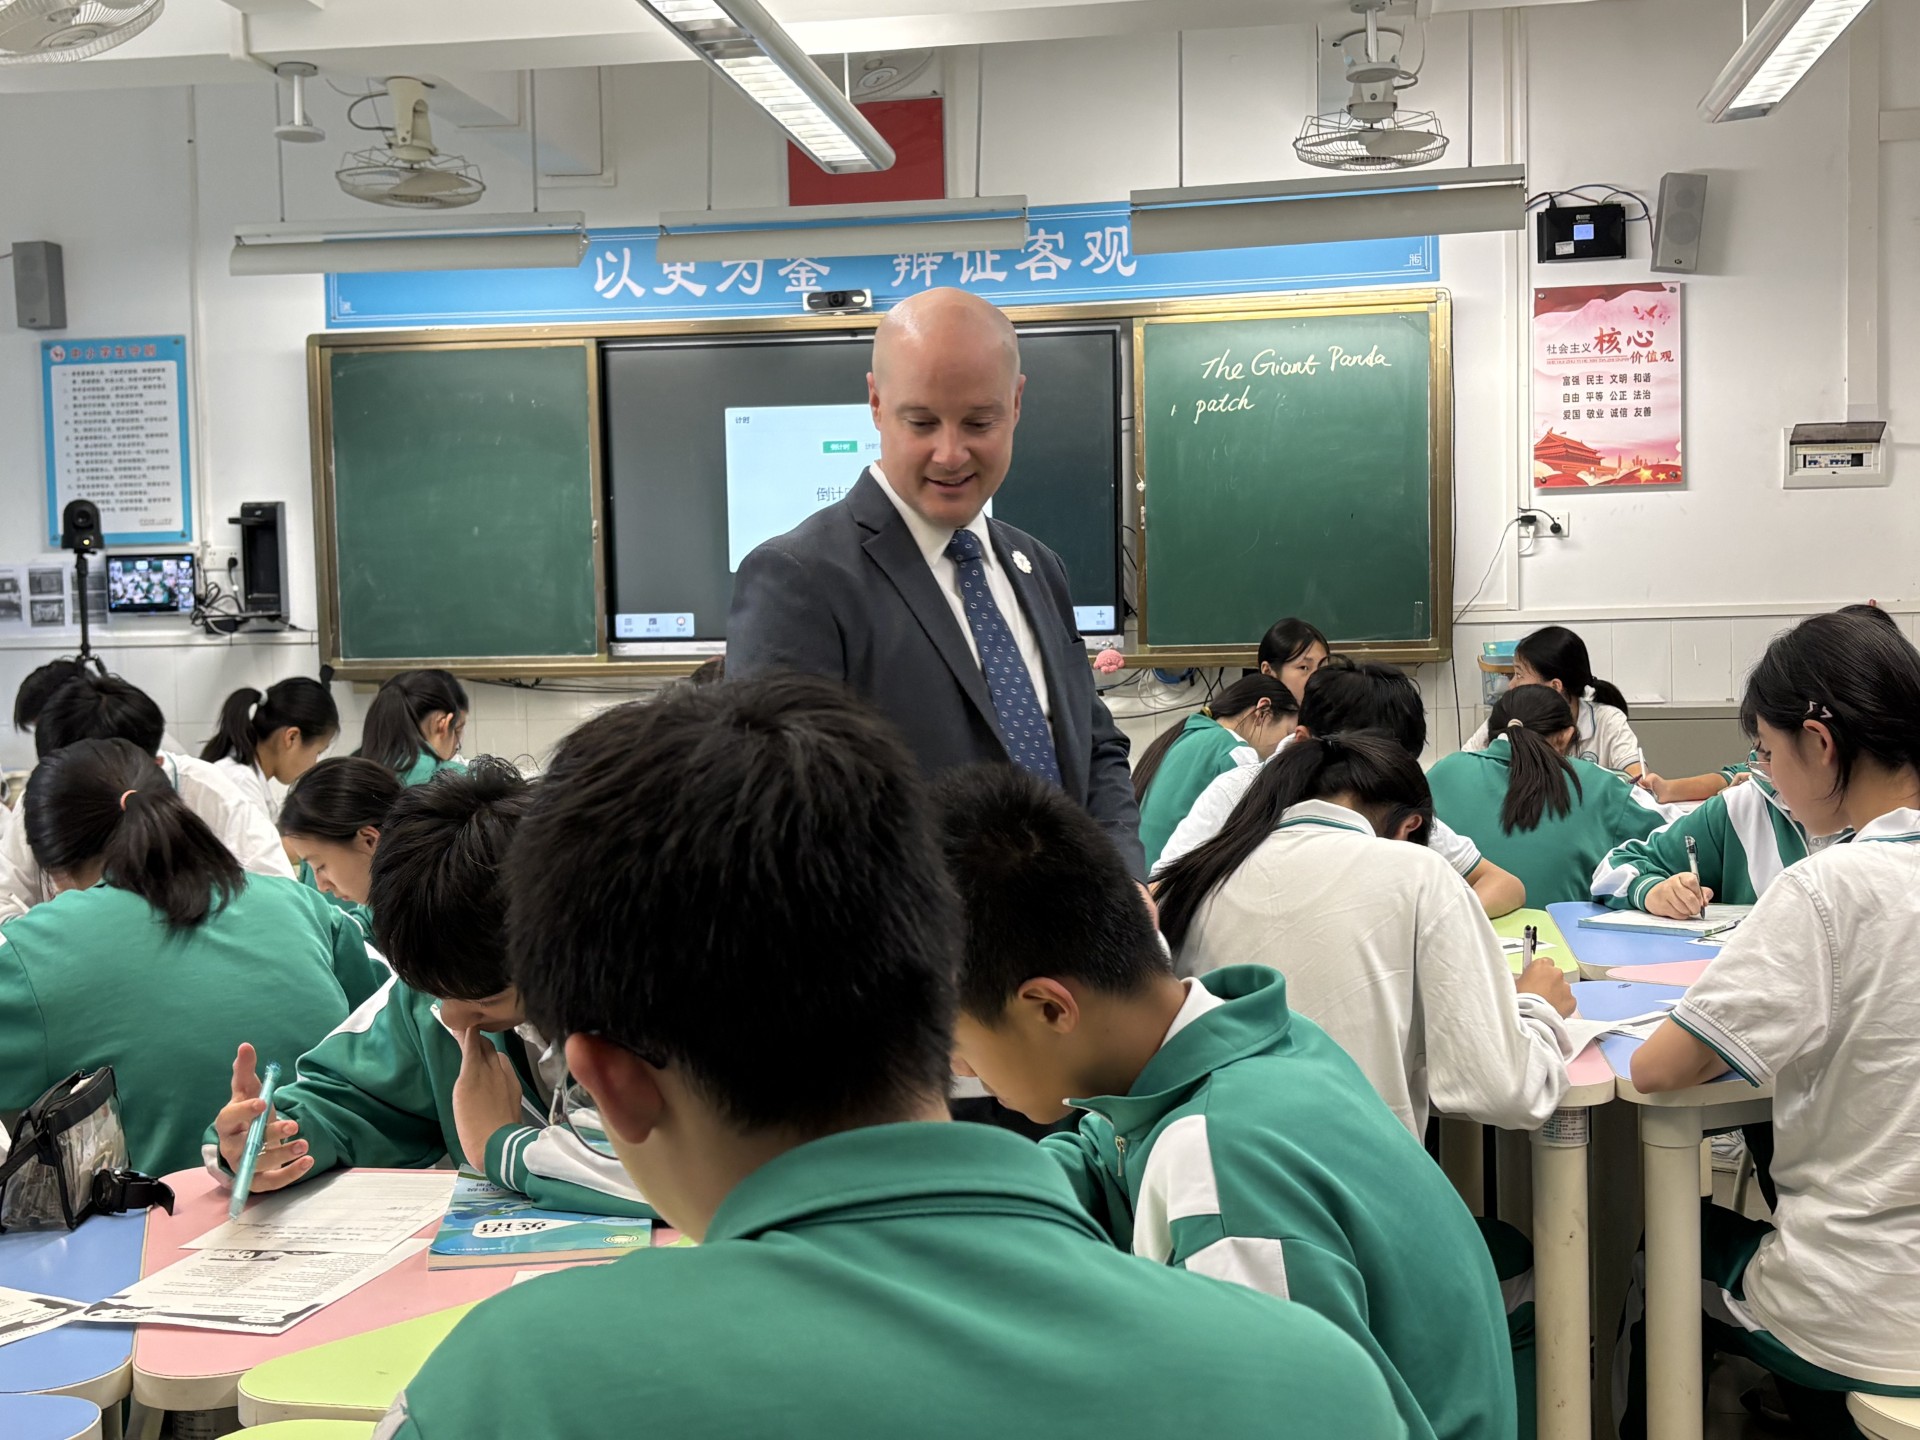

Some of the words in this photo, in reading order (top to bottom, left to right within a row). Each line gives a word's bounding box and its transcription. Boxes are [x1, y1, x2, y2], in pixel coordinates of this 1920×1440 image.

[1546, 342, 1592, 355] 社会主义
[1592, 327, 1655, 355] 核心
[1201, 349, 1245, 380] The
[1251, 348, 1321, 377] Giant
[1327, 344, 1392, 372] Panda
[1629, 350, 1675, 365] 价值观
[1562, 375, 1581, 386] 富强
[1586, 374, 1604, 386] 民主
[1609, 373, 1628, 385] 文明
[1633, 373, 1652, 384] 和谐
[1562, 392, 1580, 404] 自由
[1585, 391, 1604, 402] 平等
[1609, 390, 1628, 401] 公正
[1633, 389, 1652, 400] 法治
[1194, 385, 1256, 425] patch
[1562, 410, 1581, 421] 爱国
[1586, 409, 1605, 419] 敬业
[1610, 407, 1628, 418] 诚信
[1633, 406, 1652, 417] 友善
[816, 486, 851, 502] 倒计
